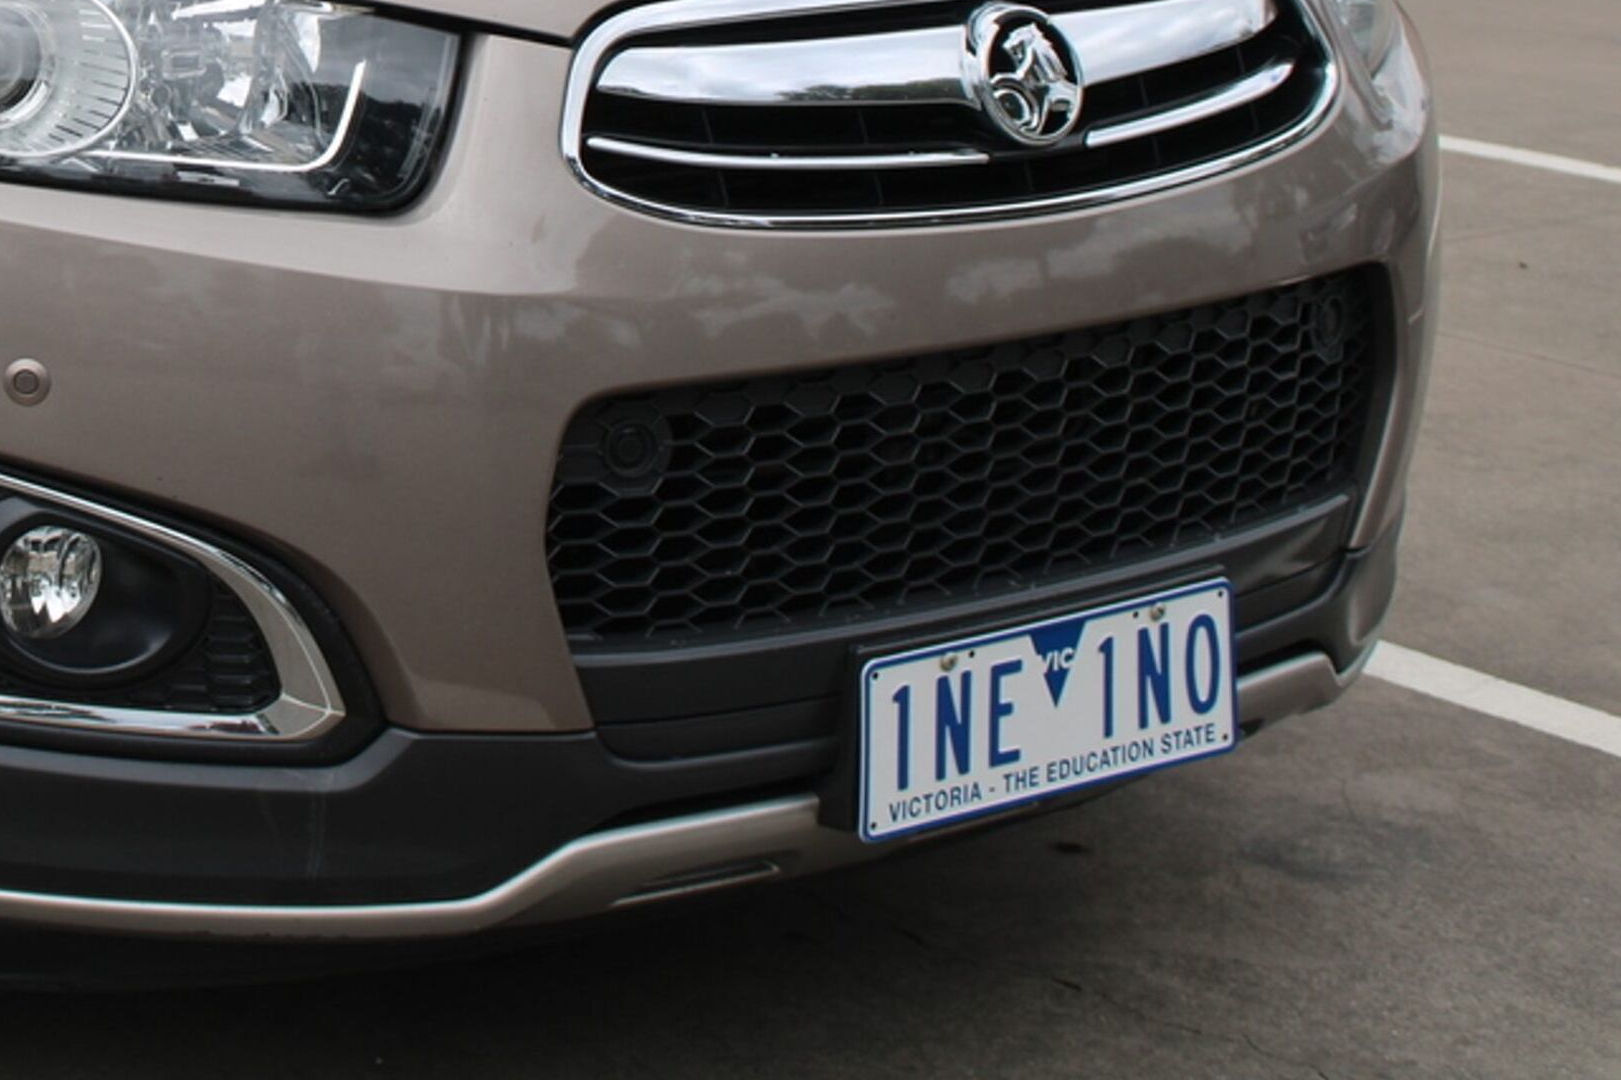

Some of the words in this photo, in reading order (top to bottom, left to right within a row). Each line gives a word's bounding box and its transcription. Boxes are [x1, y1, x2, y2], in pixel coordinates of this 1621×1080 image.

[1039, 646, 1078, 674] VIC
[888, 783, 983, 823] VICTORIA
[1002, 766, 1040, 794] THE
[1046, 740, 1155, 784] EDUCATION
[1160, 722, 1217, 756] STATE
[891, 658, 1023, 792] 1NE
